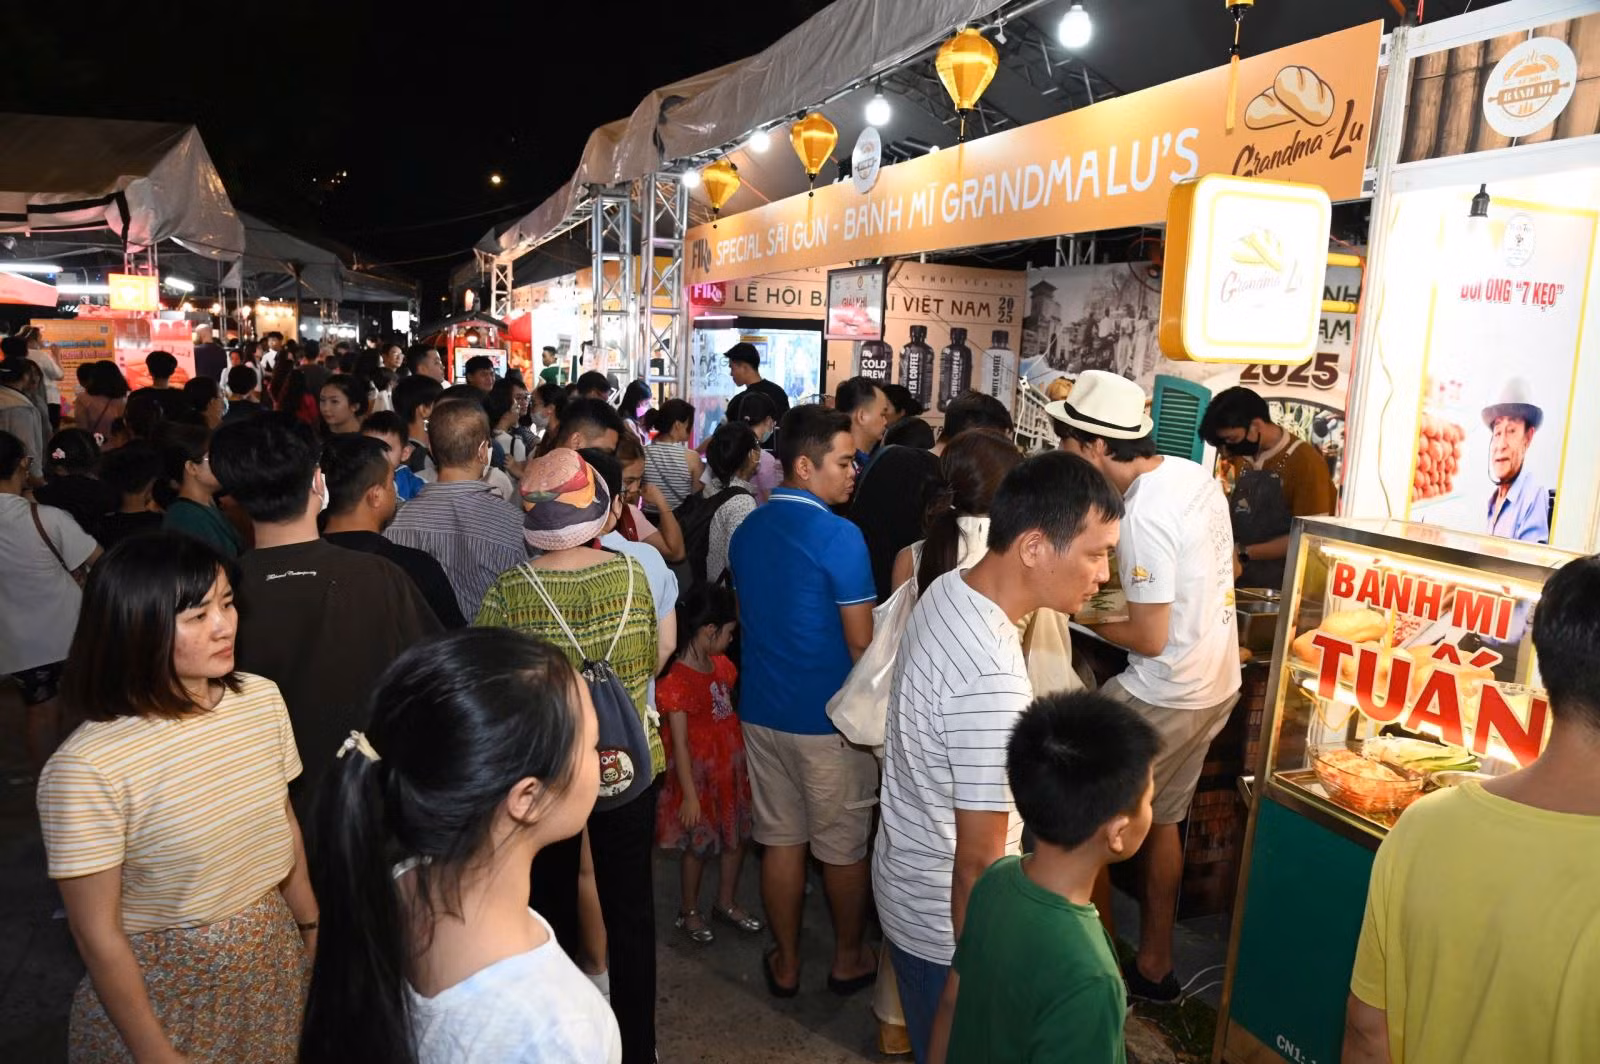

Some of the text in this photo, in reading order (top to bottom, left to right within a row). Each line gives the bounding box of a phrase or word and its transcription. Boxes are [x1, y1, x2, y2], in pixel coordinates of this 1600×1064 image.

[715, 232, 762, 266] SPECIAL
[766, 285, 802, 307] HỘI
[903, 294, 944, 316] VIỆT
[951, 300, 991, 318] NAM
[998, 296, 1014, 310] 20
[998, 310, 1013, 324] 25
[861, 359, 887, 369] COLD
[861, 369, 886, 379] BREW
[909, 352, 919, 379] COFFEE
[1332, 558, 1514, 640] BÁNH MÌ
[1312, 633, 1550, 768] TUẤN
